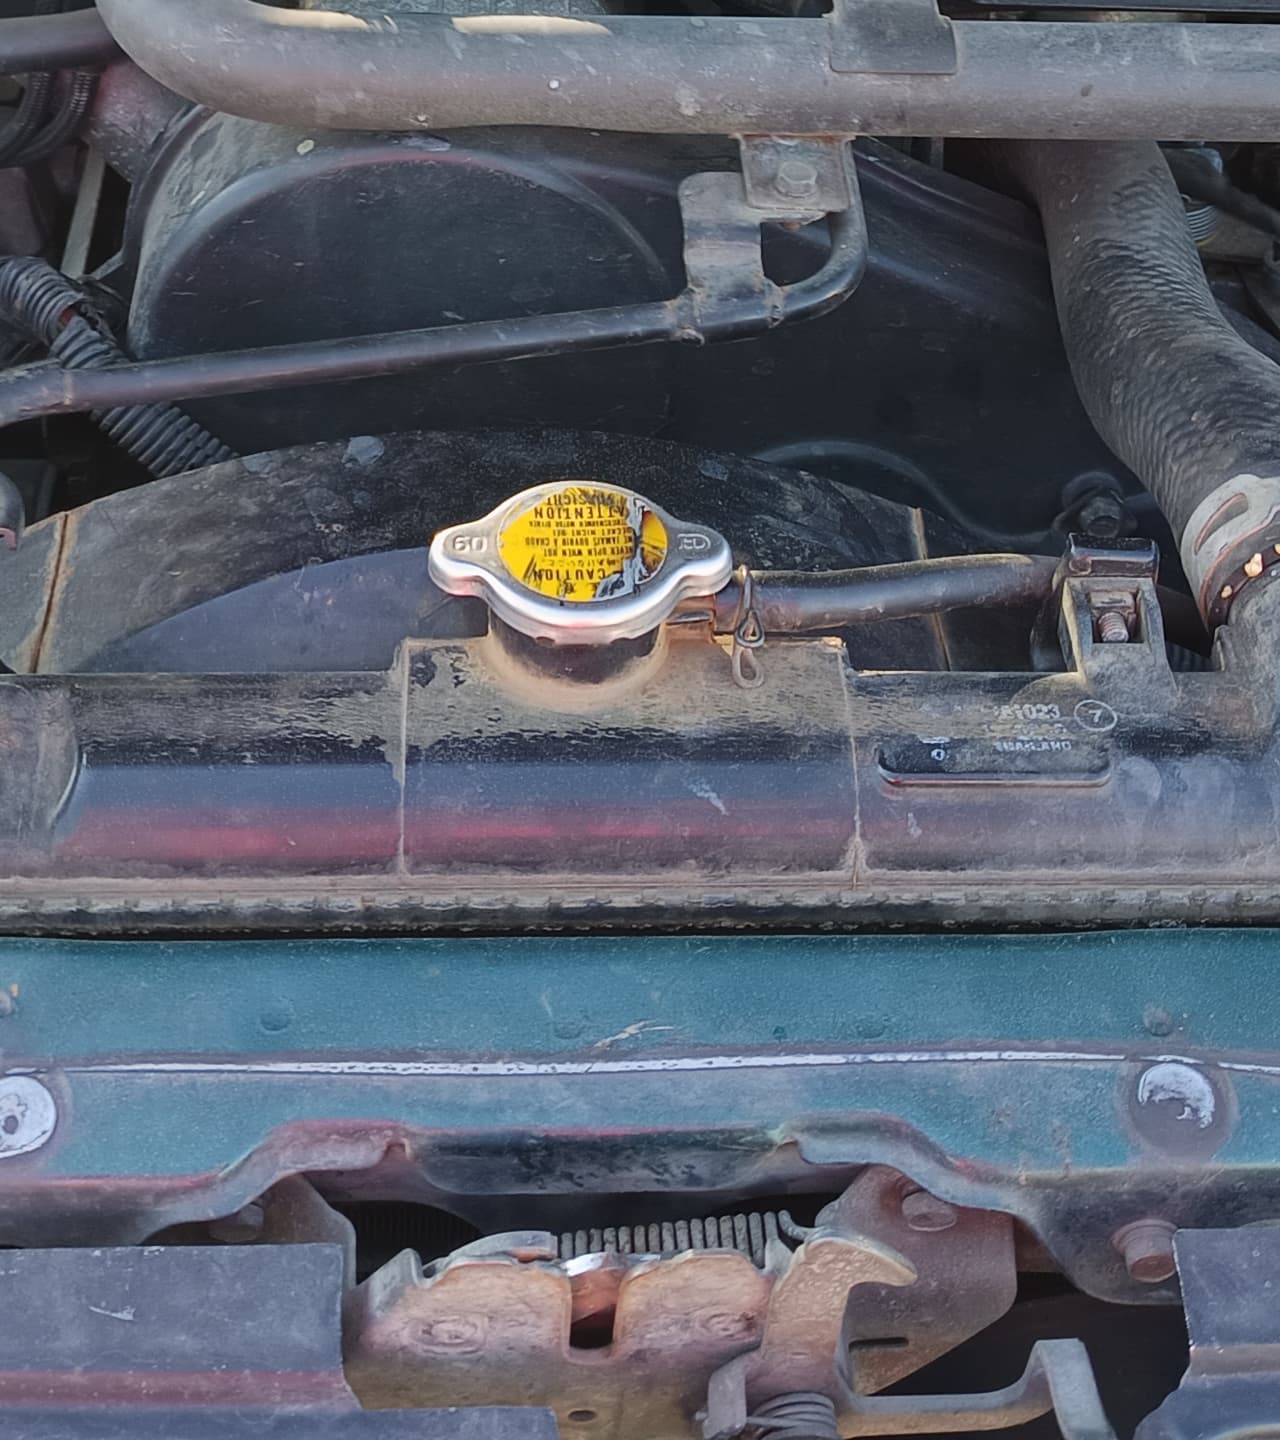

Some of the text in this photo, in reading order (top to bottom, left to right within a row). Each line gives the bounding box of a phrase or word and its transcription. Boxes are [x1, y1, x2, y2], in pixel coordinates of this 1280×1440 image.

[534, 505, 625, 520] ATTENTION
[571, 528, 596, 537] NICHT
[524, 536, 550, 547] CHAUD
[593, 536, 620, 546] JAMAIS
[543, 548, 558, 557] HOT
[562, 548, 583, 557] WHEN
[588, 547, 607, 557] OPEN
[533, 568, 606, 581] CAUTION
